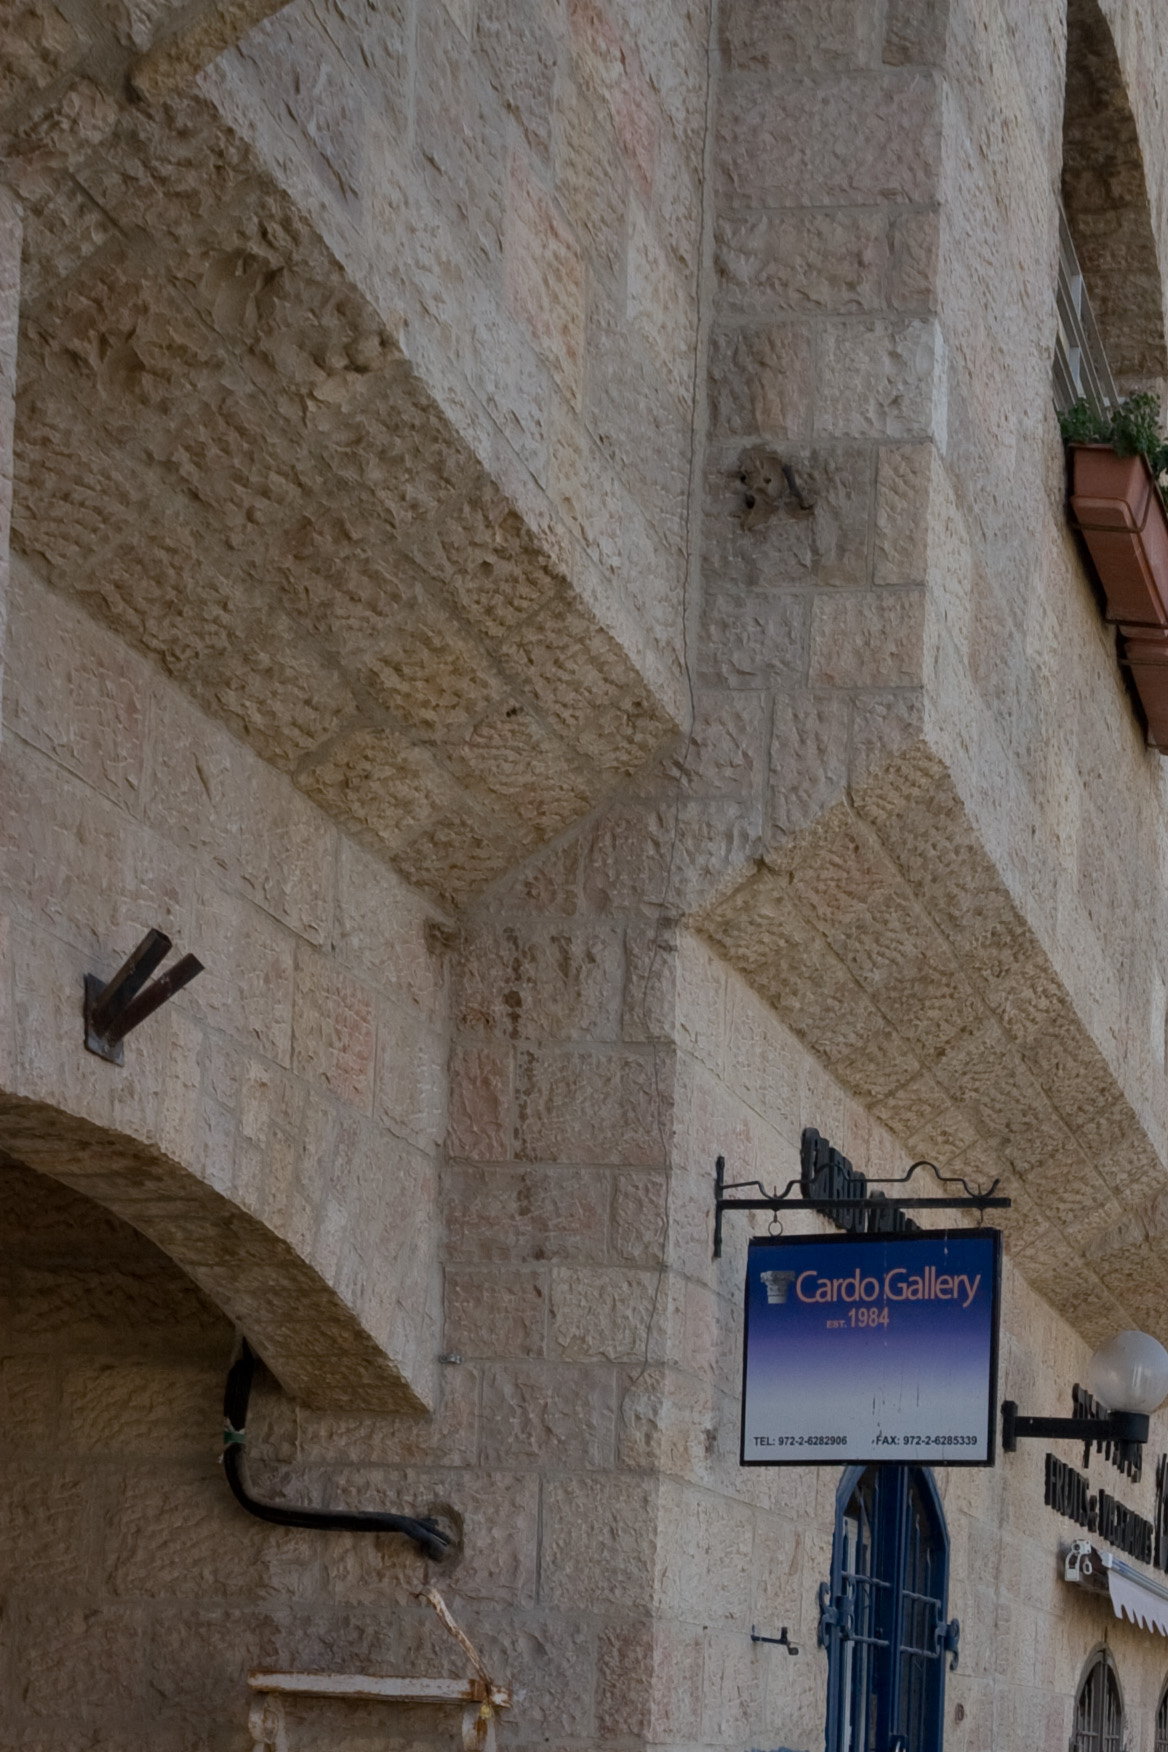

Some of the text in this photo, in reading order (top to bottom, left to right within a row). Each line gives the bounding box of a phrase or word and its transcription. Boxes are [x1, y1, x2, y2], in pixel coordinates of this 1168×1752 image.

[796, 1266, 981, 1308] Cardo Gallery
[827, 1308, 889, 1328] EST. 1984
[753, 1436, 847, 1446] TEL: 972-2-6282906
[875, 1436, 978, 1446] FAX: 972-2-6285339
